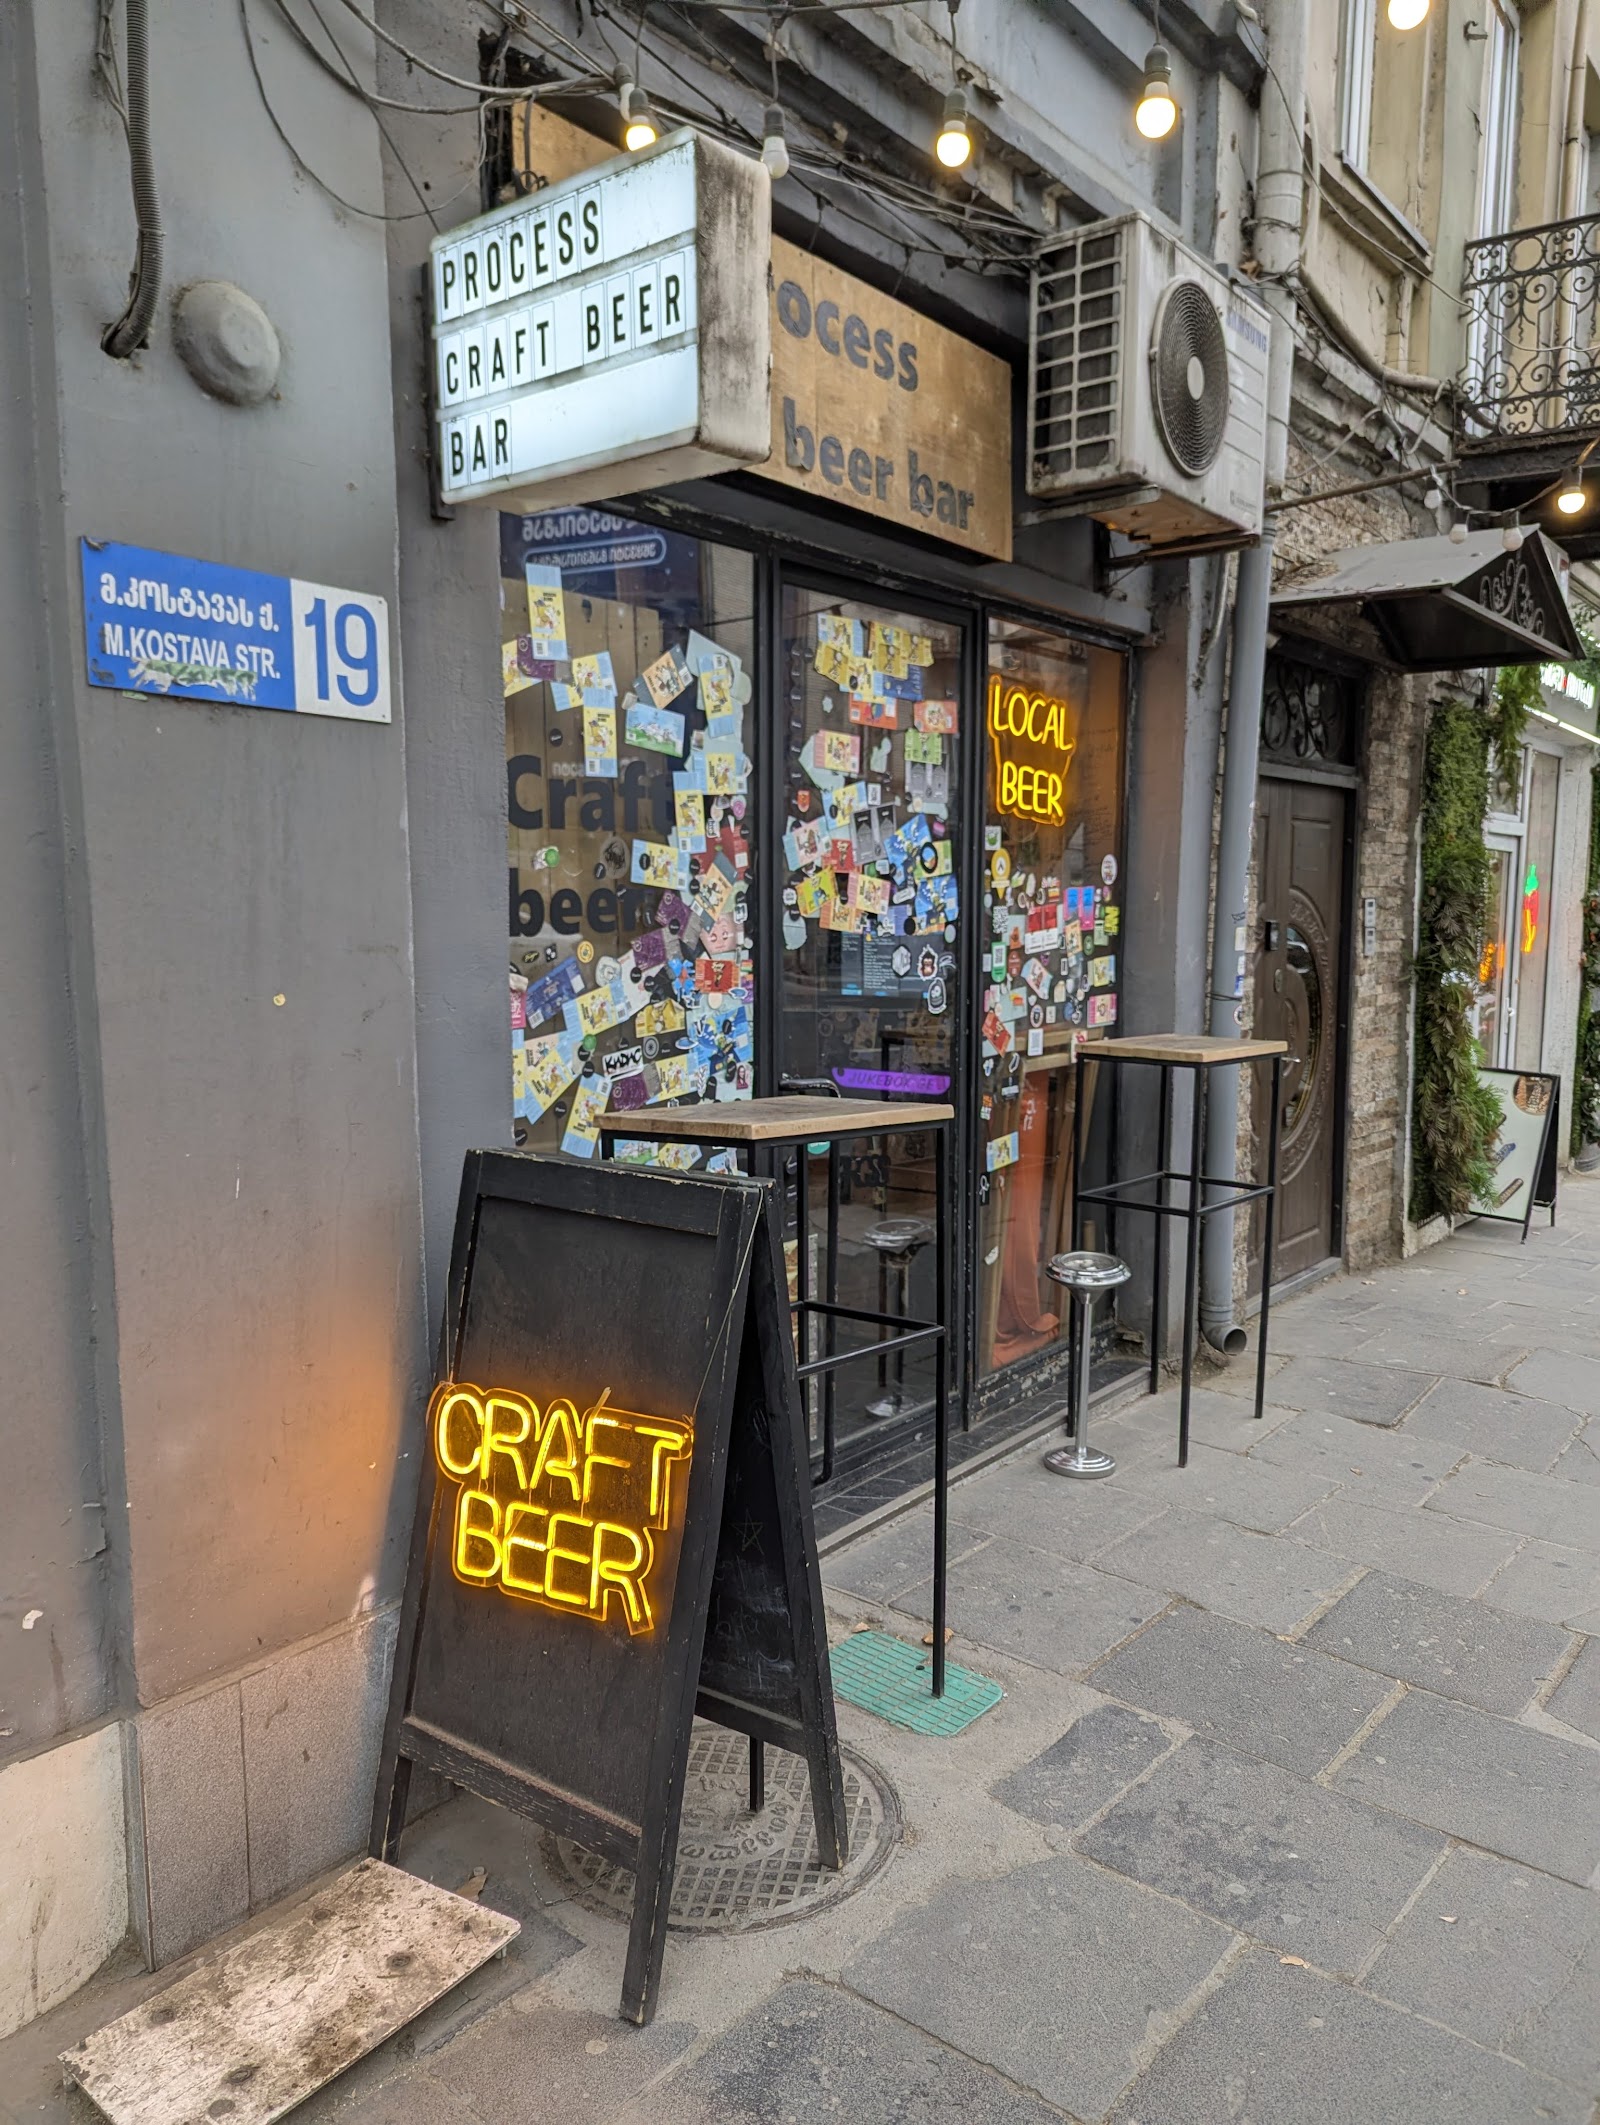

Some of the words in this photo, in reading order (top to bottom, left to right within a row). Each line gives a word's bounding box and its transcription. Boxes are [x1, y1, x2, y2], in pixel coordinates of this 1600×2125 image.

[442, 200, 600, 310] PROCESS
[446, 320, 550, 394] CRAFT
[586, 274, 681, 353] BEER
[770, 272, 919, 392] ocess
[1226, 310, 1267, 353] SAMSUNG
[451, 418, 509, 475] BAR
[783, 396, 894, 502] beer
[909, 449, 975, 530] bar
[100, 572, 253, 628] მ.კოსტავას
[259, 602, 280, 632] ქ.
[104, 622, 231, 669] M.KOSTAVA
[235, 647, 281, 679] STR.
[304, 597, 379, 707] 19
[993, 684, 1073, 751] LOCAL
[507, 754, 674, 833] Craft
[1002, 760, 1063, 817] BEER
[509, 867, 646, 938] beer
[438, 1392, 686, 1516] CRAFT
[456, 1490, 643, 1622] BEER
